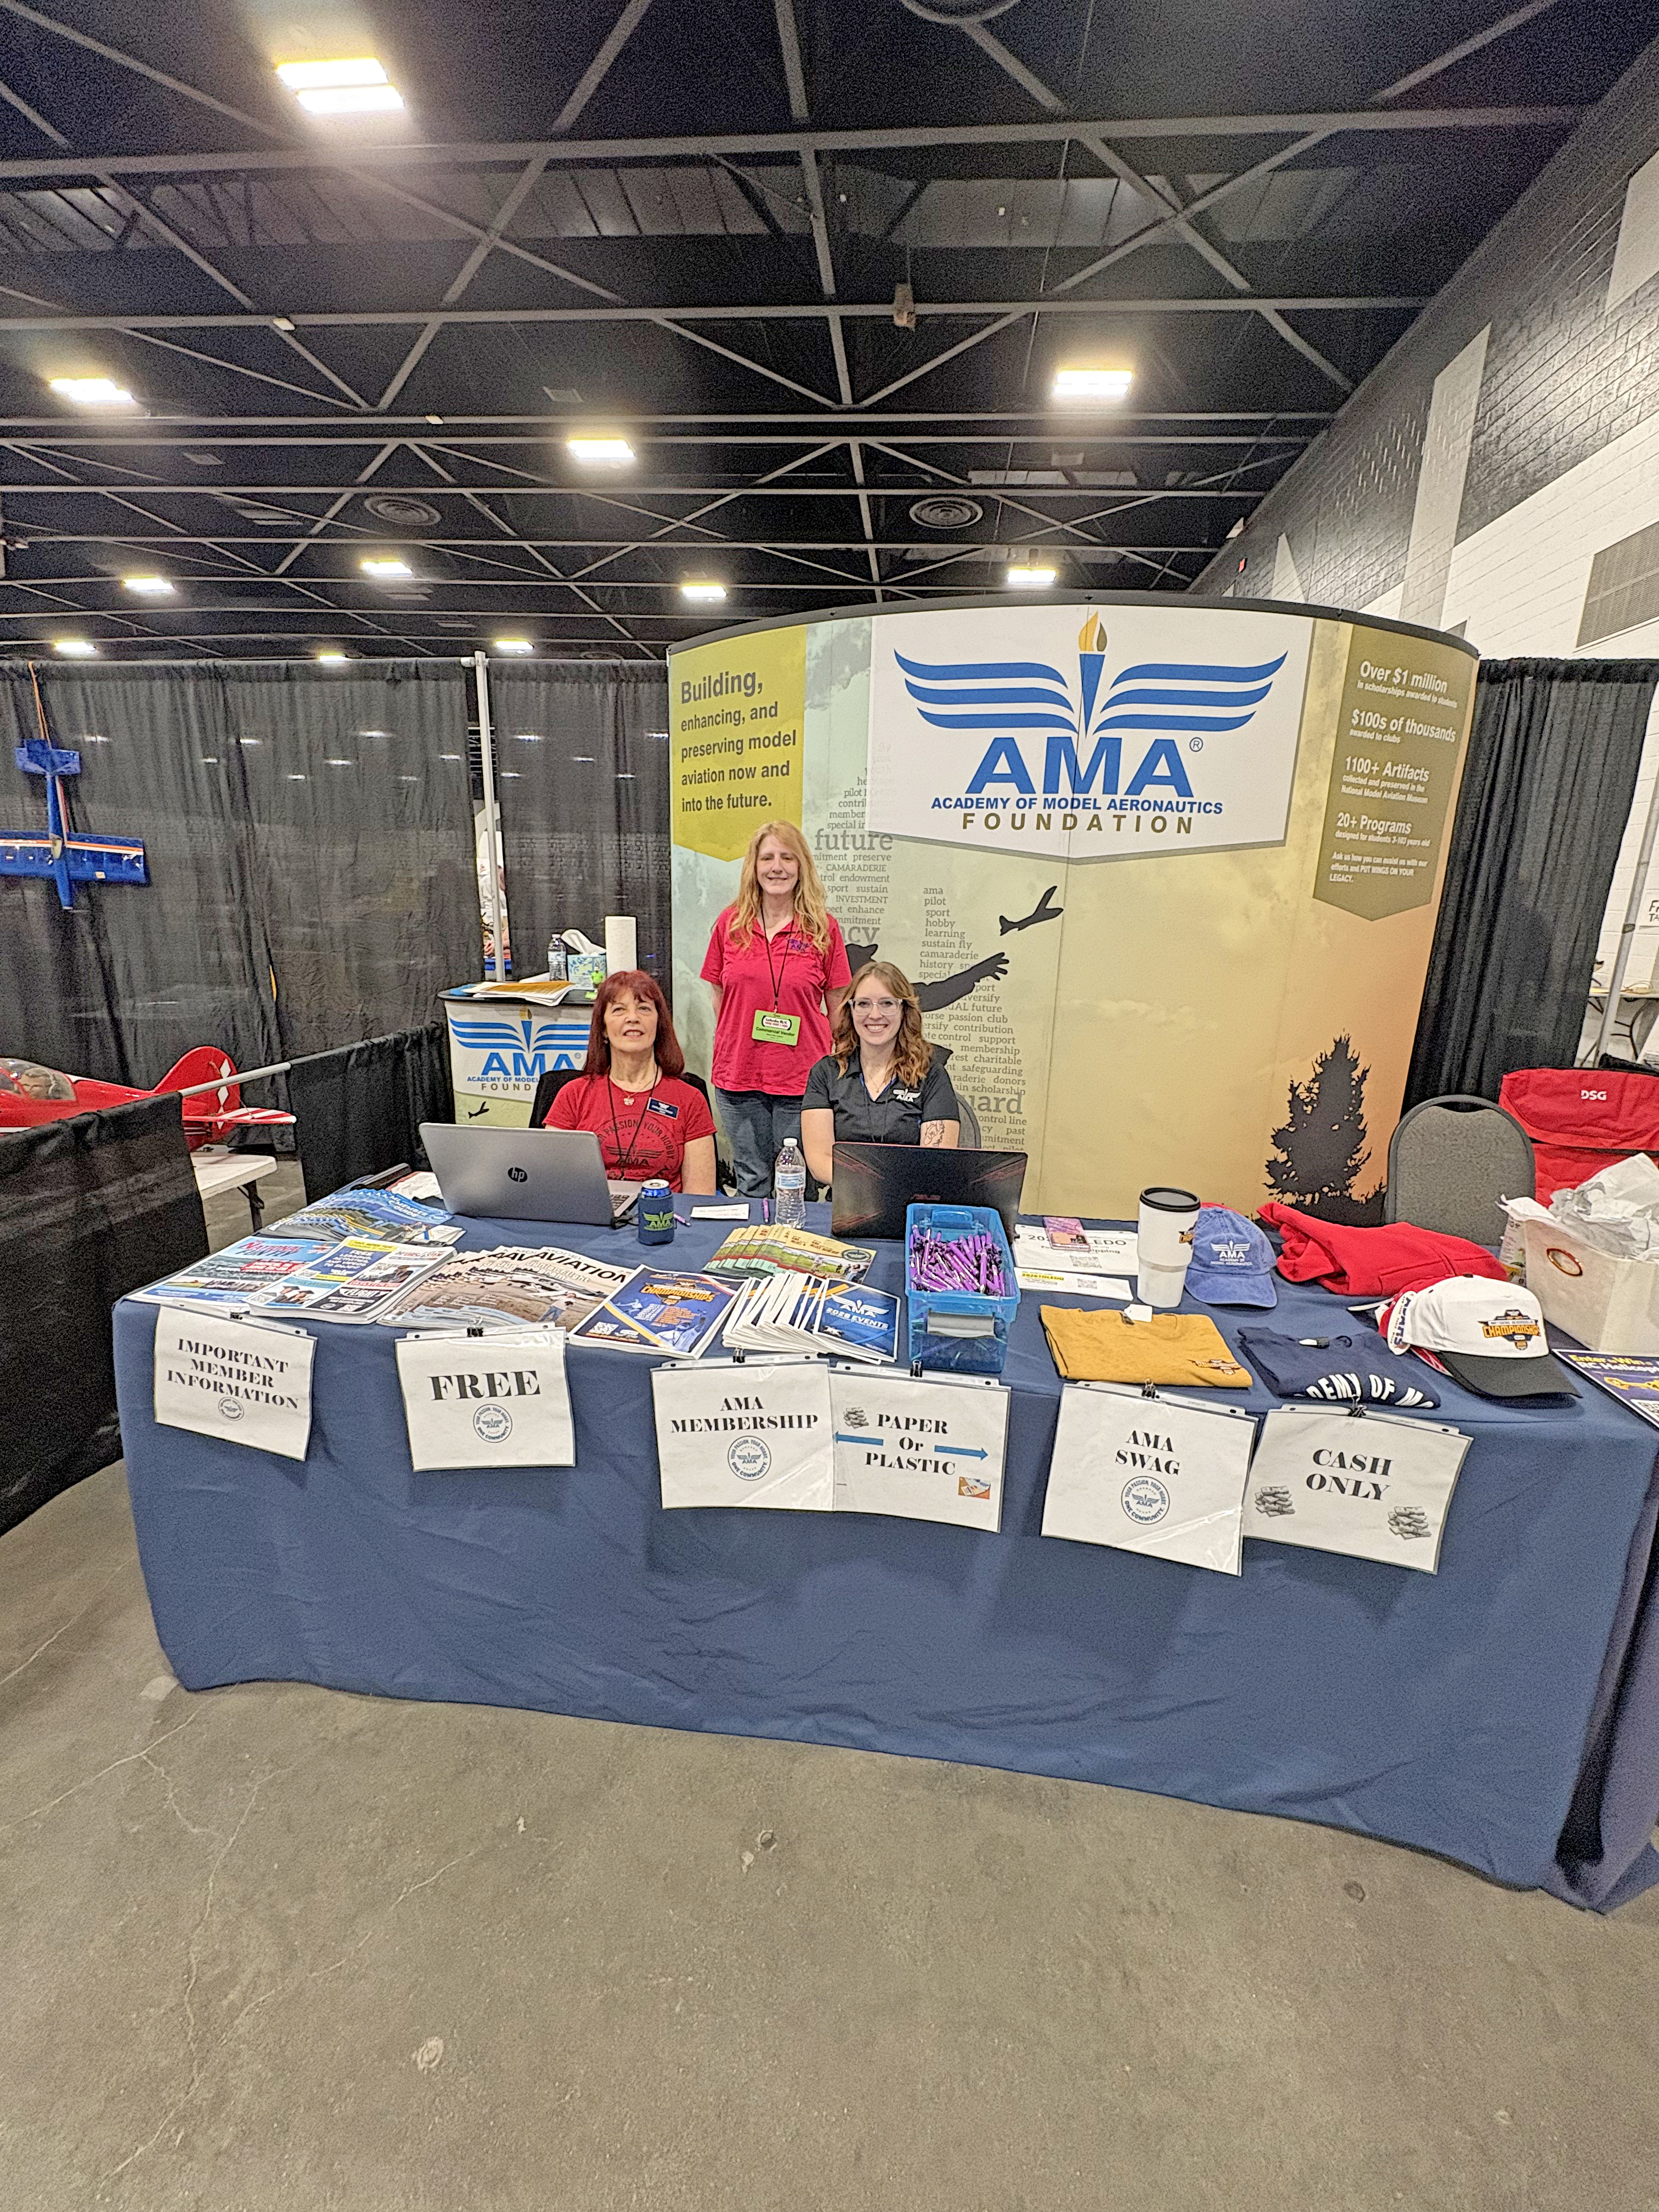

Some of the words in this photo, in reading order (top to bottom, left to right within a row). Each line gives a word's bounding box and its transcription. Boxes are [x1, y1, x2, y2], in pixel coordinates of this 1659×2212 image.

[1360, 661, 1391, 681] Over
[1392, 667, 1408, 685] $1
[1410, 673, 1448, 693] million
[681, 671, 763, 703] Building,
[1364, 682, 1405, 697] scholarships
[1406, 690, 1431, 702] awarded
[681, 708, 746, 732] enhancing,
[750, 701, 778, 720] and
[1351, 709, 1387, 730] $100s
[1390, 717, 1404, 732] of
[1405, 719, 1456, 742] thousands
[1350, 729, 1374, 740] awarded
[1383, 733, 1401, 743] clubs
[681, 737, 744, 763] preserving
[749, 730, 797, 750] model
[681, 768, 724, 786] aviation
[729, 766, 757, 779] now
[761, 760, 790, 777] and
[964, 736, 1194, 798] AMA
[1346, 756, 1379, 775] 1100+
[1383, 761, 1430, 782] Artifacts
[1343, 775, 1367, 785] collected
[1368, 778, 1380, 787] and
[1380, 781, 1410, 791] preserved
[844, 788, 861, 798] pilot
[681, 797, 702, 812] into
[705, 796, 723, 811] the
[726, 793, 772, 809] future.
[931, 797, 1009, 809] ACADEMY
[1016, 797, 1037, 809] OF
[1043, 798, 1102, 810] MODEL
[1107, 798, 1222, 814] AERONAUTICS
[827, 822, 856, 830] special
[962, 812, 1193, 834] FOUNDATION
[1336, 812, 1357, 828] 20+
[1360, 815, 1412, 835] Programs
[815, 828, 893, 850] future
[853, 853, 891, 862] preserve
[1332, 851, 1343, 860] Ask
[827, 885, 848, 893] sport
[856, 885, 888, 893] sustain
[836, 895, 888, 904] INVESTMENT
[924, 897, 946, 906] pilot
[848, 905, 884, 913] enhance
[926, 909, 950, 917] sport
[925, 918, 956, 928] hobby
[925, 928, 966, 939] learning
[922, 940, 955, 949] sustain
[958, 940, 973, 950] fly
[920, 950, 979, 960] camaraderie
[919, 960, 953, 970] history
[975, 984, 995, 992] port
[972, 1004, 1002, 1012] future
[949, 1013, 983, 1022] passion
[987, 1014, 1008, 1023] club
[953, 1024, 1013, 1034] contribution
[979, 1035, 1015, 1045] support
[961, 1045, 1020, 1055] membership
[481, 1052, 575, 1076] AMA
[974, 1054, 1022, 1065] charitable
[962, 1064, 1023, 1076] safeguarding
[994, 1076, 1026, 1085] donors
[972, 1085, 1026, 1095] scholarship
[1581, 1090, 1607, 1101] DSG
[977, 1115, 1007, 1124] ontrol
[1009, 1116, 1027, 1125] line
[1006, 1127, 1025, 1135] past
[511, 1167, 525, 1182] hp
[650, 1220, 670, 1228] AMA
[641, 1285, 716, 1302] CHAMPIONSHIPS
[840, 1304, 877, 1318] AMA
[851, 1316, 889, 1329] EVENTS
[178, 1339, 289, 1374] IMPORTANT
[1568, 1355, 1606, 1363] Enter
[190, 1359, 275, 1387] MEMBER
[167, 1370, 299, 1409] INFORMATION
[427, 1370, 540, 1401] FREE
[1369, 1374, 1396, 1400] OF
[720, 1396, 765, 1412] AMA
[670, 1414, 819, 1434] MEMBERSHIP
[877, 1413, 949, 1435] PAPER
[899, 1436, 926, 1452] Or
[1125, 1430, 1175, 1453] AMA
[865, 1452, 956, 1476] PLASTIC
[1115, 1449, 1181, 1477] SWAG
[1312, 1448, 1395, 1477] CASH
[1306, 1473, 1391, 1502] ONLY
